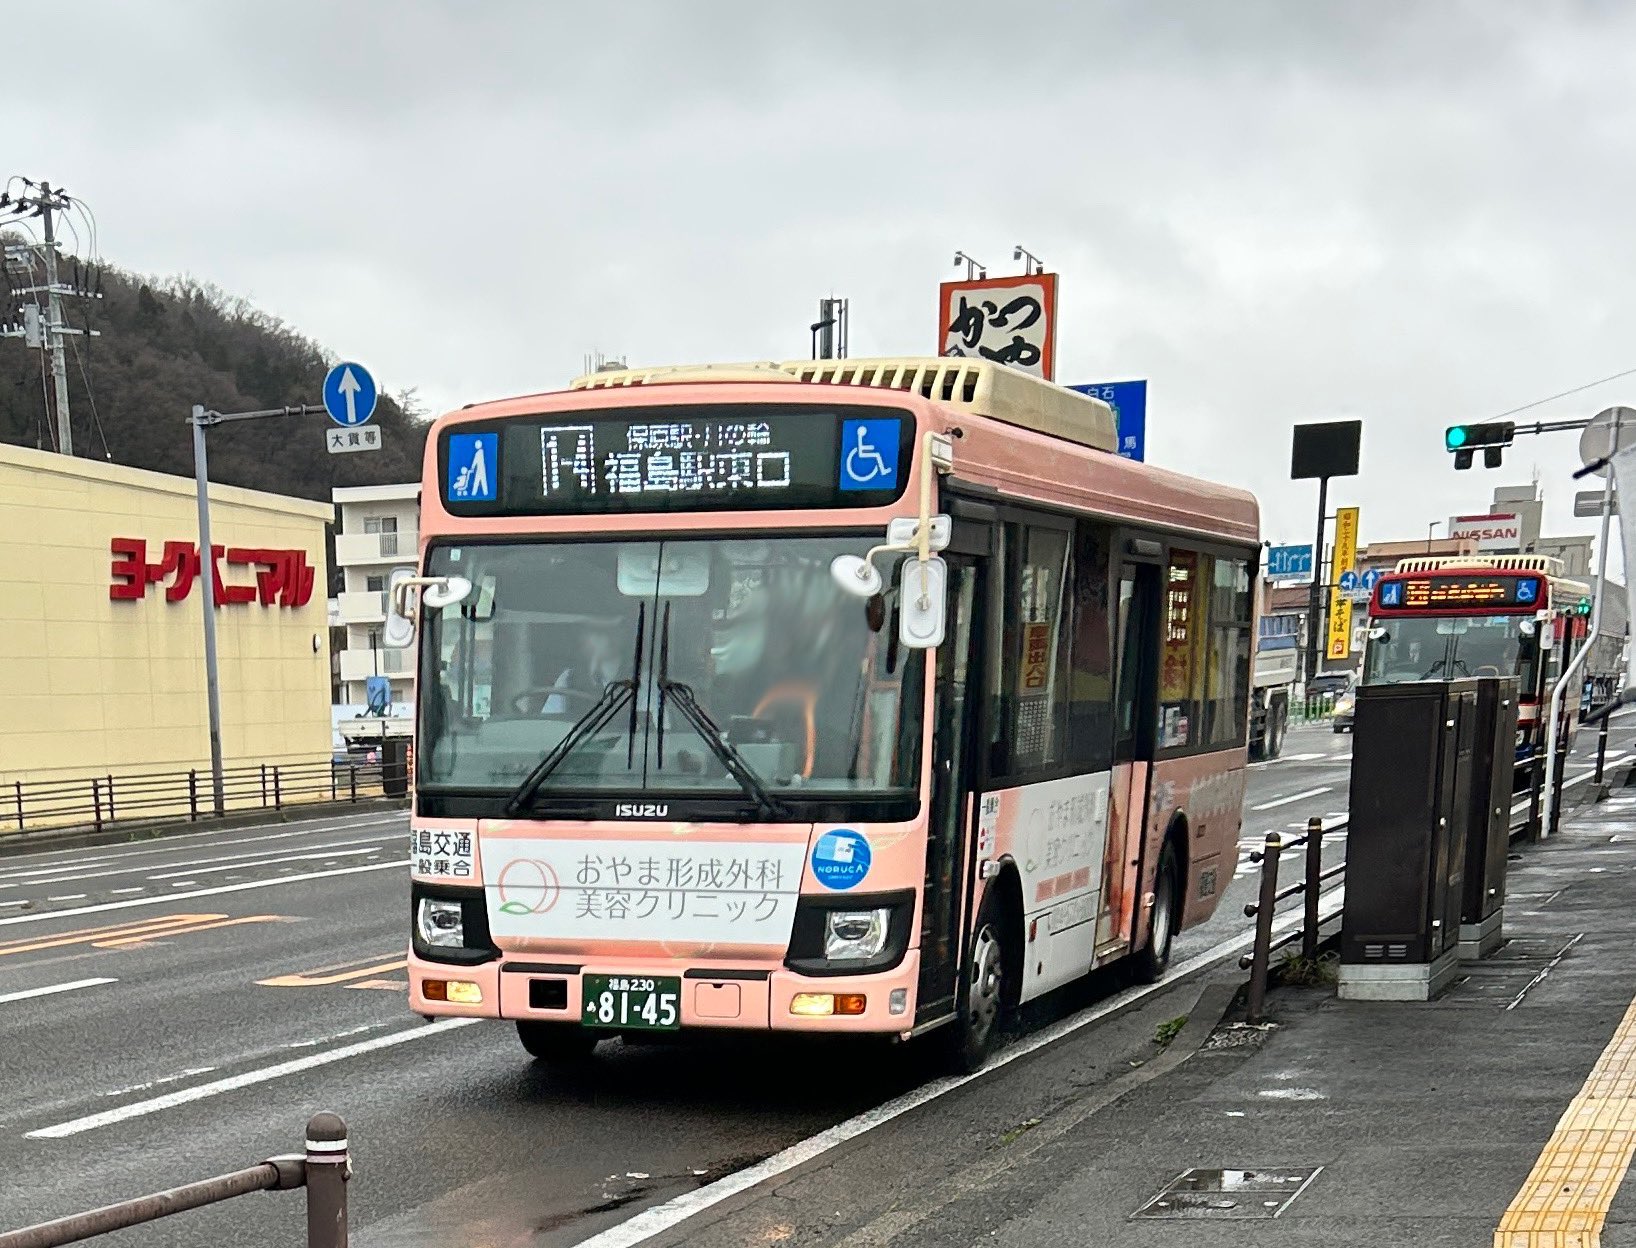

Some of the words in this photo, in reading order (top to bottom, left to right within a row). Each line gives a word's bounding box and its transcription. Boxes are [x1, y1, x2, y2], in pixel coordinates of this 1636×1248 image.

[1087, 386, 1115, 399] 白石
[331, 431, 376, 447] 大貨等
[605, 449, 790, 493] 福島駅東口
[1452, 528, 1517, 541] NISSAN
[110, 537, 315, 607] ヨークベニマル
[615, 803, 668, 818] ISUZU
[576, 854, 785, 889] おやま形成外科
[817, 864, 864, 874] NORUCA
[575, 888, 780, 922] 美容クリニック
[630, 979, 654, 991] 230
[598, 991, 677, 1026] 81-45
